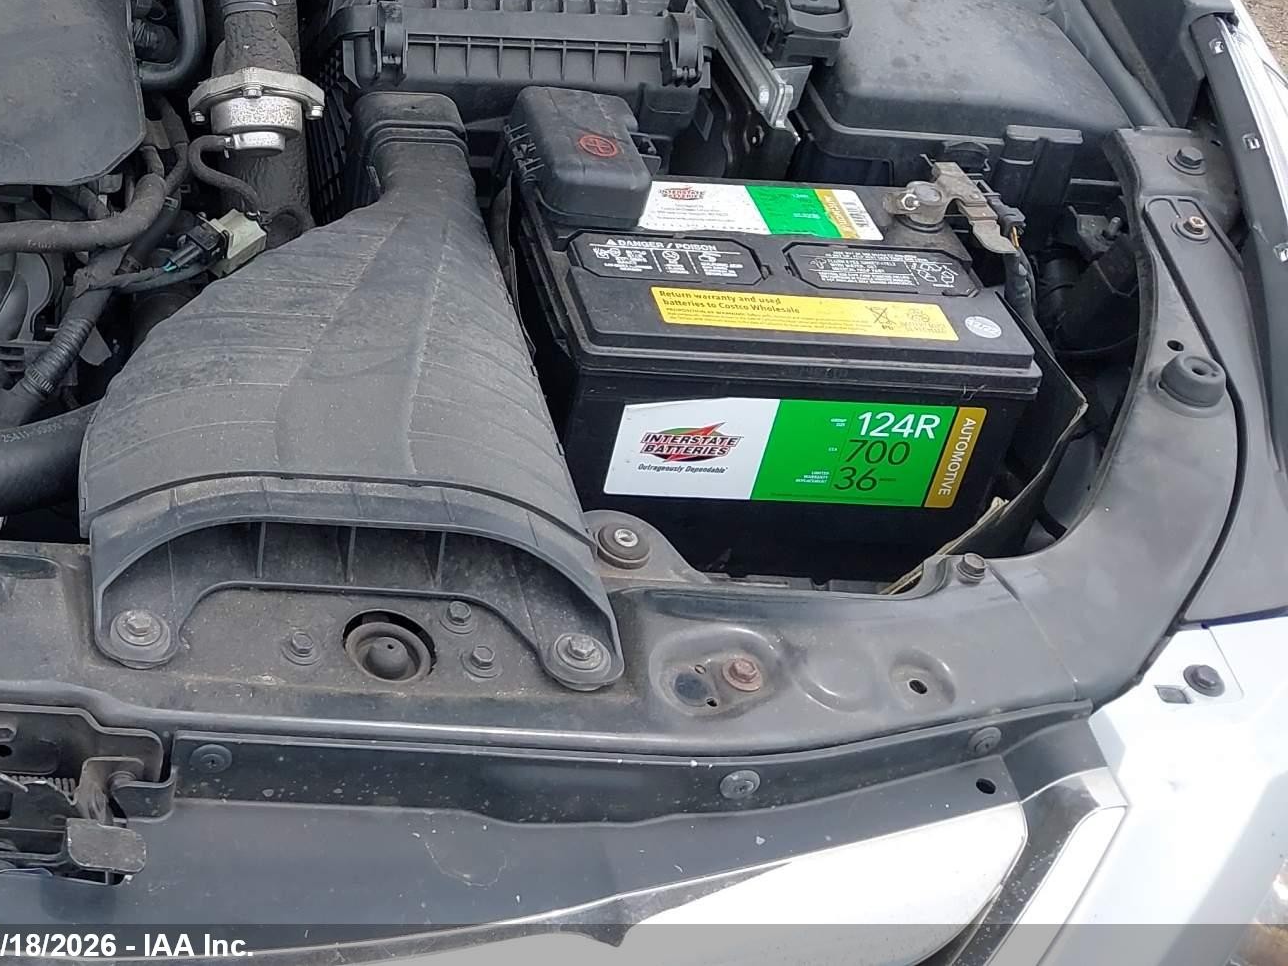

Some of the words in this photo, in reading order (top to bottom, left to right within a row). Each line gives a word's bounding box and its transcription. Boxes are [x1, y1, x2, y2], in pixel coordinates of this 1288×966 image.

[618, 239, 664, 249] DANGER
[675, 243, 717, 251] POISON
[659, 291, 692, 299] Return
[694, 293, 736, 302] warranty
[662, 298, 705, 308] batteries
[719, 303, 749, 311] Costco
[751, 304, 800, 314] Wholesale
[857, 411, 941, 439] 124R
[644, 434, 738, 446] INTERSTATE
[644, 445, 728, 455] BATTERIES
[845, 439, 911, 465] 700
[938, 417, 977, 496] AUTOMOTIVE
[638, 463, 683, 472] Outrageously
[685, 465, 726, 474] Dependable
[833, 466, 878, 491] 36
